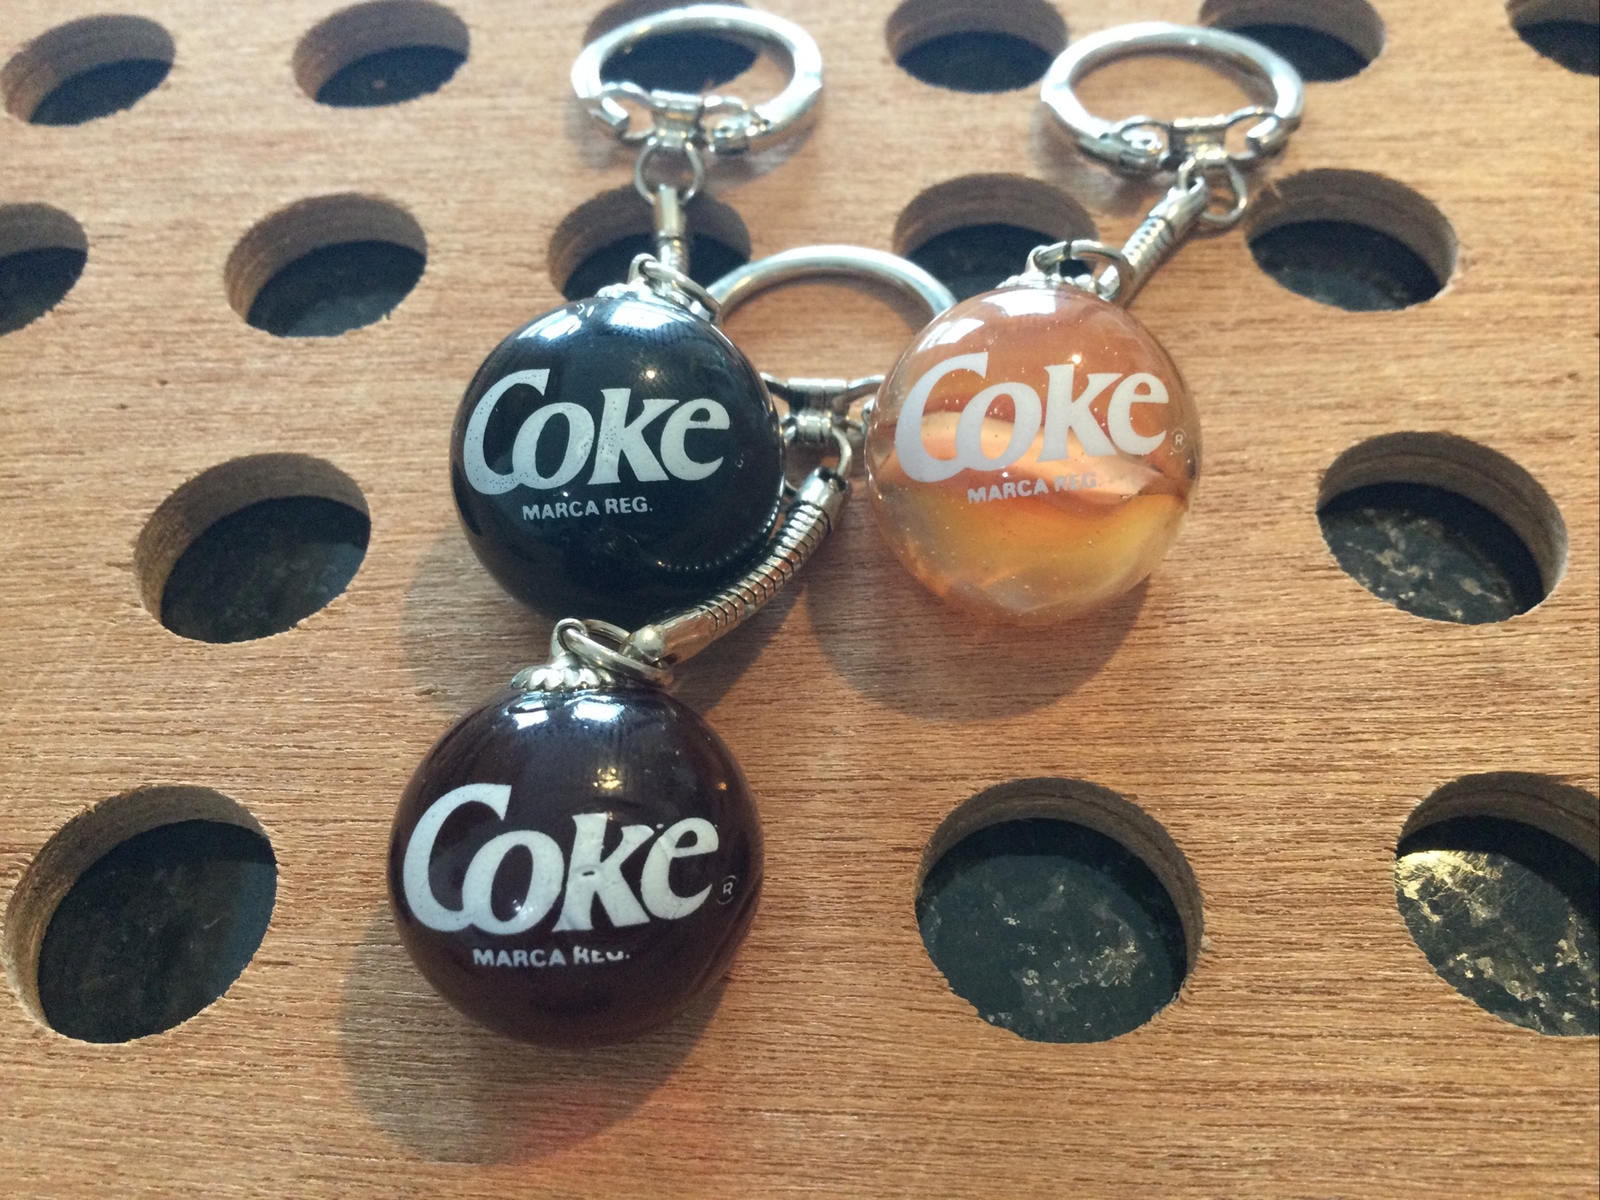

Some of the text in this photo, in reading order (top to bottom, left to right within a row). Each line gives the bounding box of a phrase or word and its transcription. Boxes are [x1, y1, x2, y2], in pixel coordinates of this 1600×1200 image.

[463, 367, 731, 496] Coke
[894, 351, 1170, 483] Coke
[522, 496, 654, 521] MARCA REG.
[967, 476, 1050, 504] MARCA
[403, 782, 720, 936] Coke
[472, 947, 568, 969] MARCA
